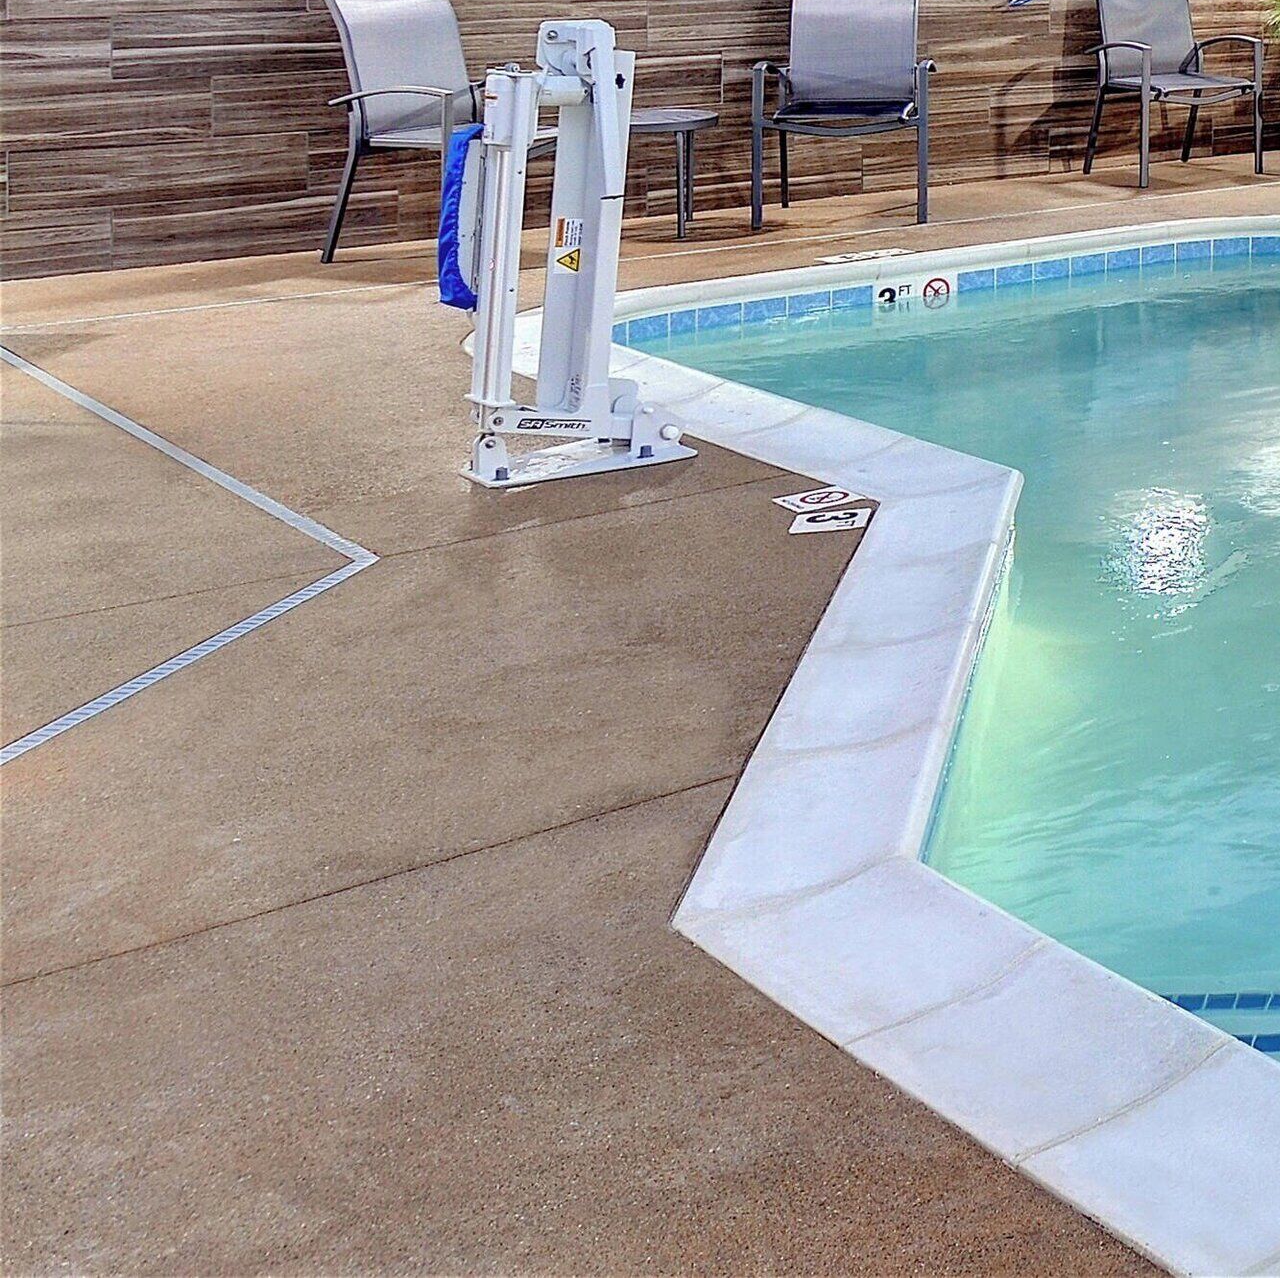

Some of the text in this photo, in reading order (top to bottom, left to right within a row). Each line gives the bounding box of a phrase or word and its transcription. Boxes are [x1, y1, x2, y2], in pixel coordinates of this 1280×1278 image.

[898, 284, 912, 296] FT
[544, 421, 586, 429] Smith
[806, 512, 859, 523] 3
